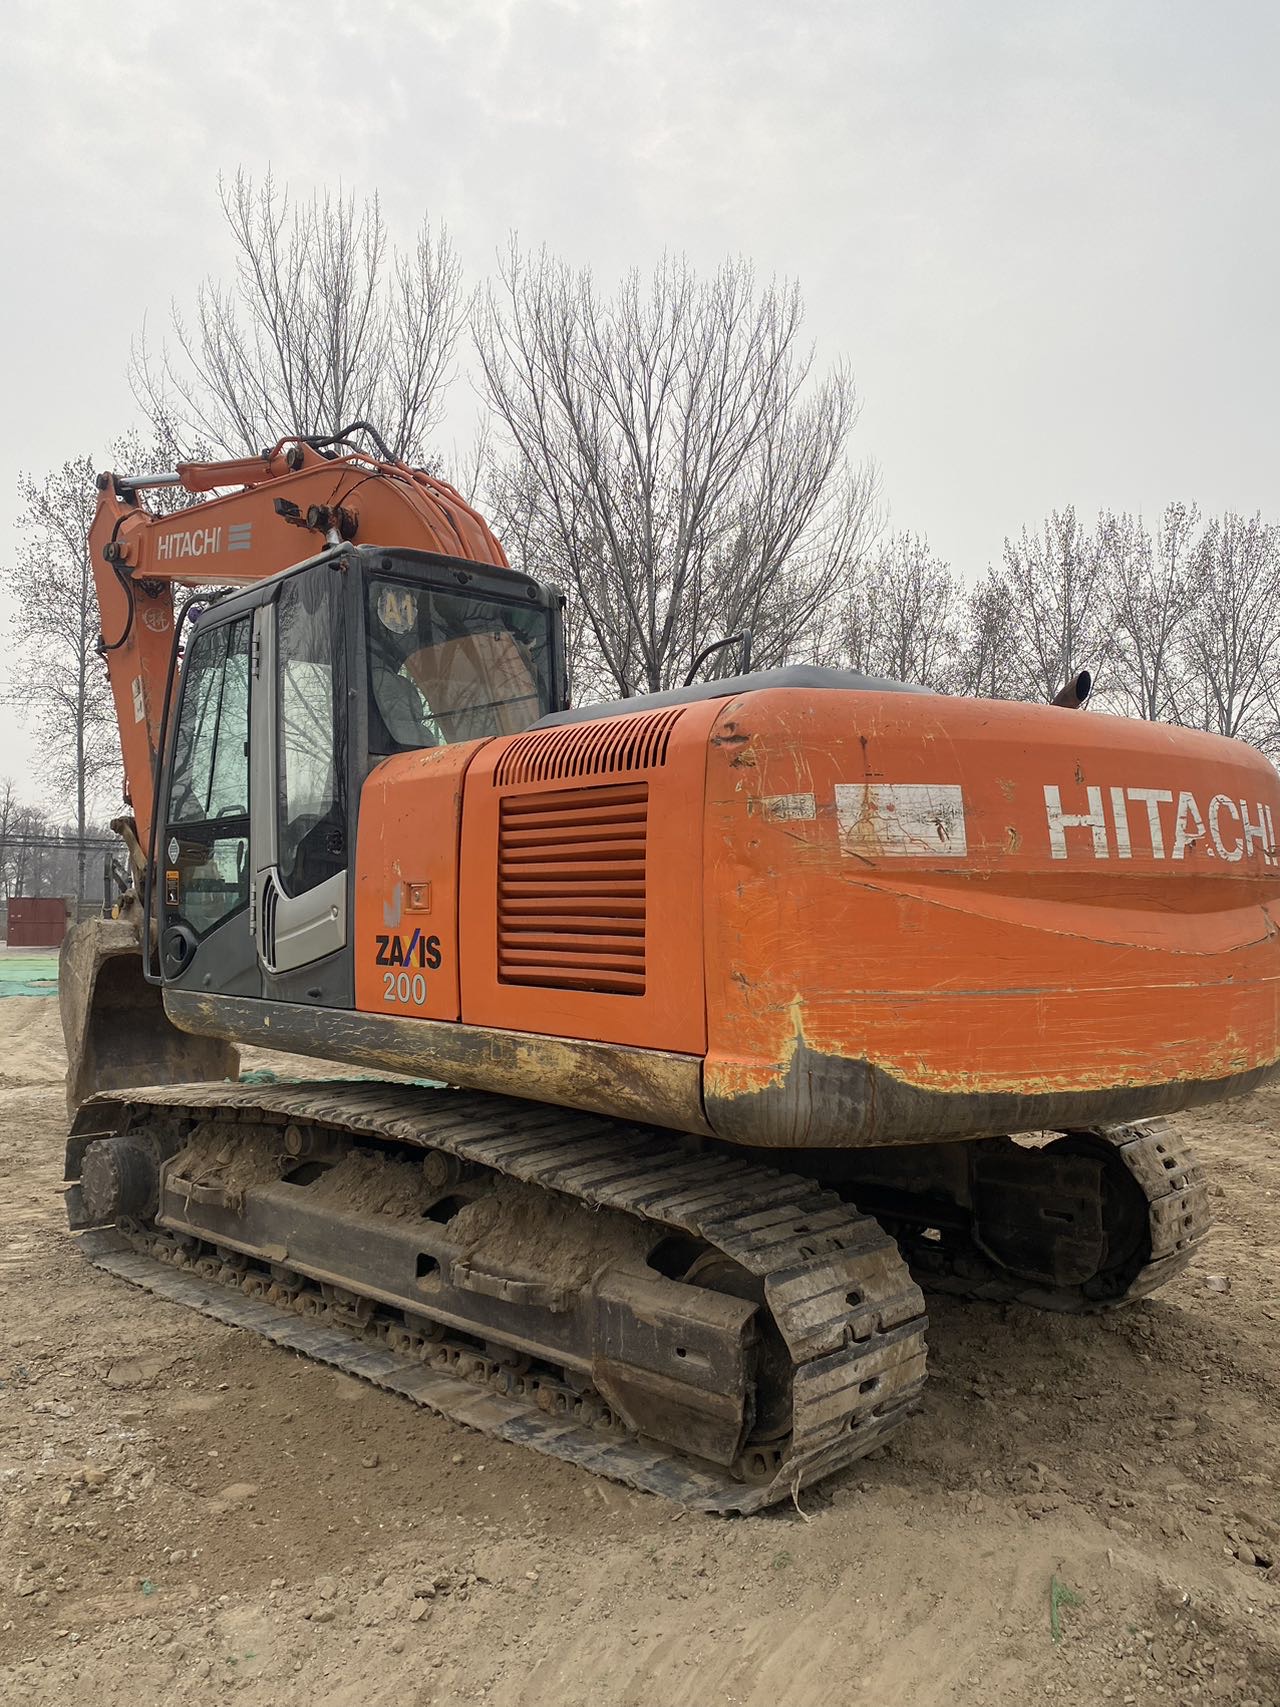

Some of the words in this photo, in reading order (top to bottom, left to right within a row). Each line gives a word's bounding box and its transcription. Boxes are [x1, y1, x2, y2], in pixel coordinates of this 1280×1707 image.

[157, 526, 222, 561] HITACHI
[1043, 784, 1279, 867] HITACHI
[375, 927, 442, 970] ZAXIS
[383, 971, 427, 1006] 200
